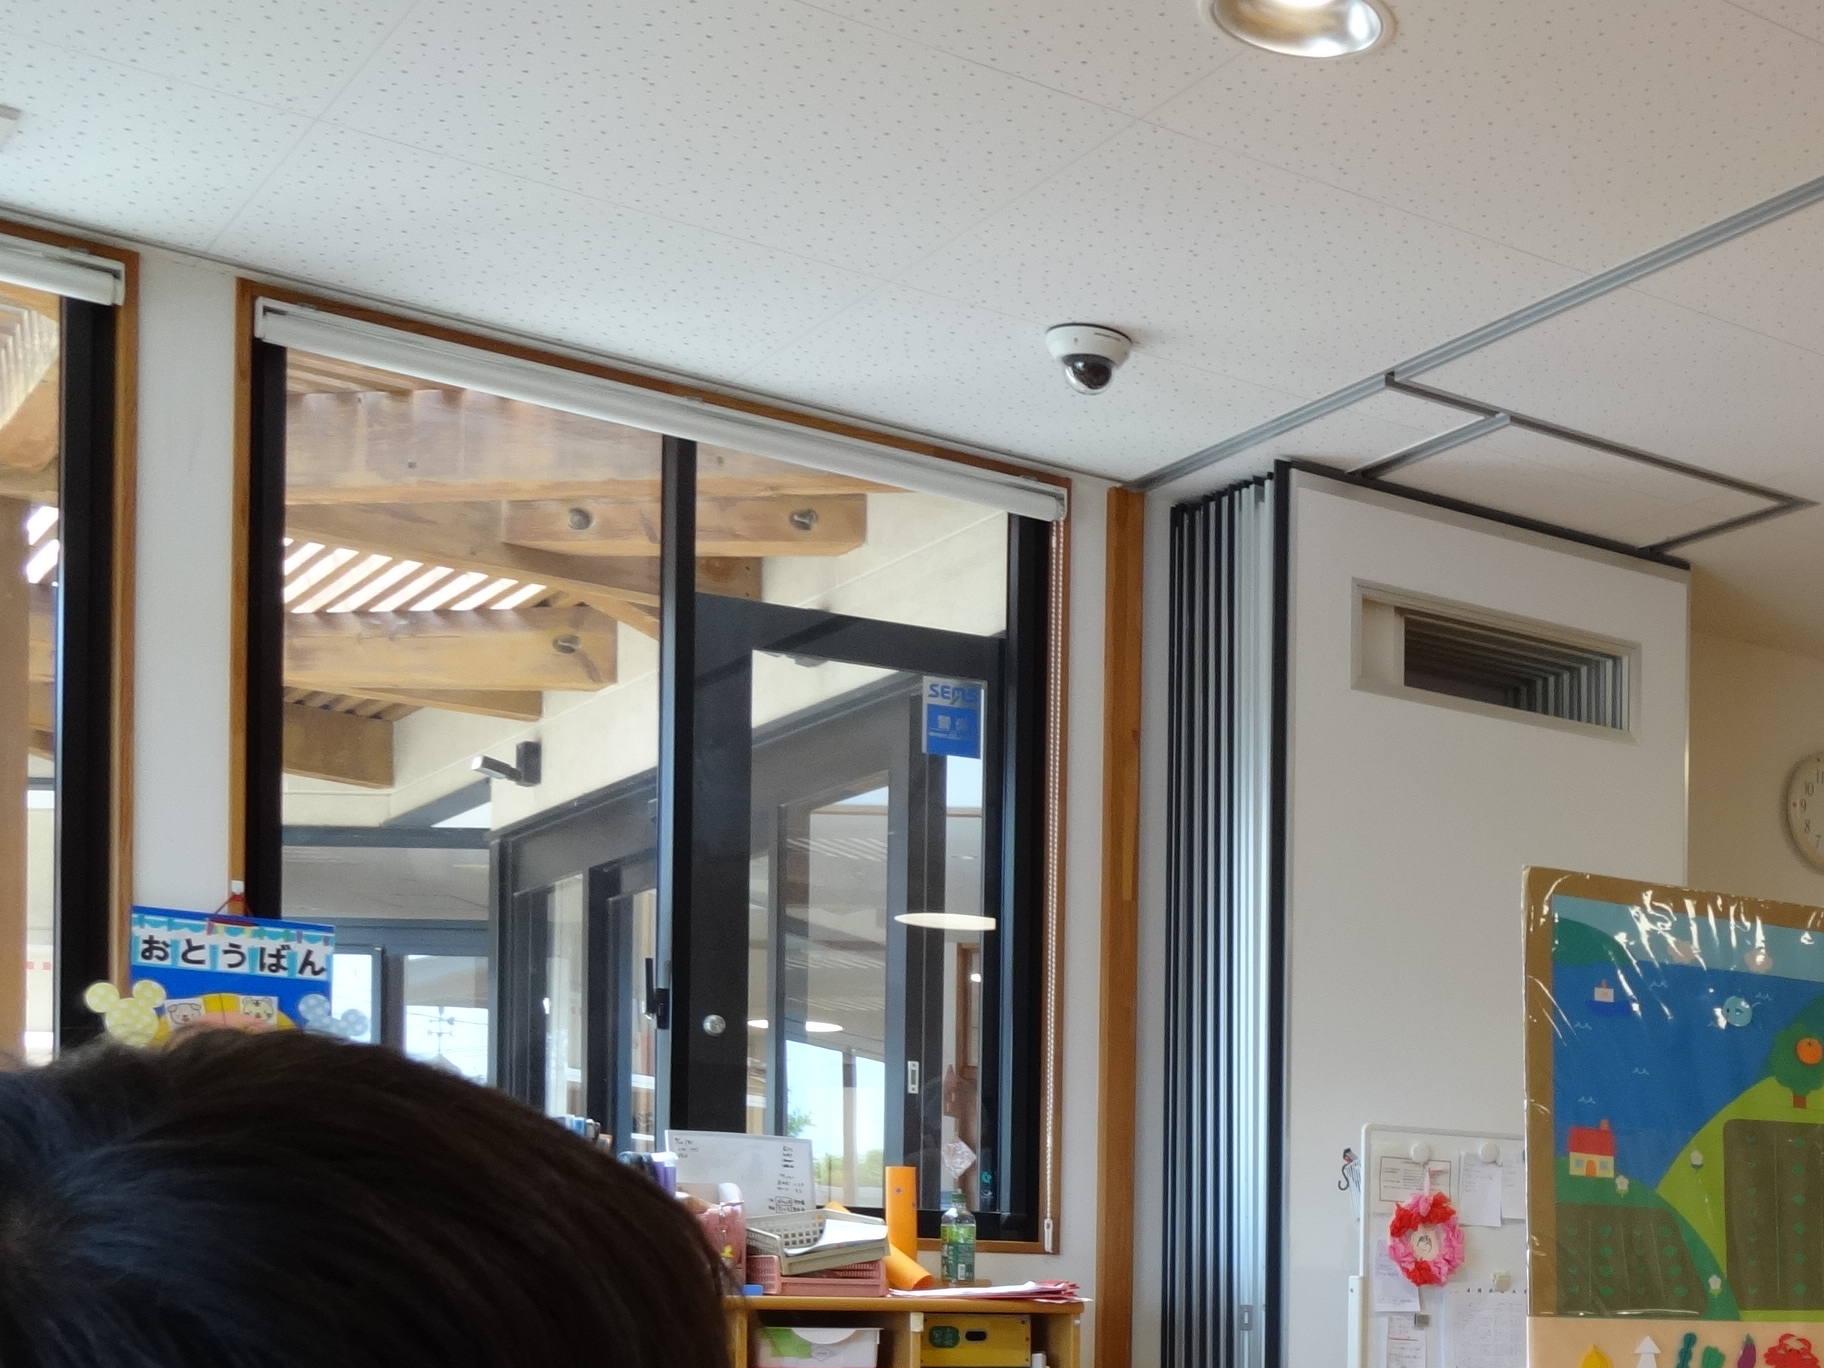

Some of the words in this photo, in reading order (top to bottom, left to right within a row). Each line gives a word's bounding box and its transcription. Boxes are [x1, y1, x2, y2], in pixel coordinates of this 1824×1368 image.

[1816, 768, 1824, 784] 11
[1804, 780, 1815, 797] 10
[1801, 798, 1807, 813] 9
[1804, 819, 1811, 834] 8
[1815, 834, 1821, 849] 7
[140, 934, 327, 976] おとうばん
